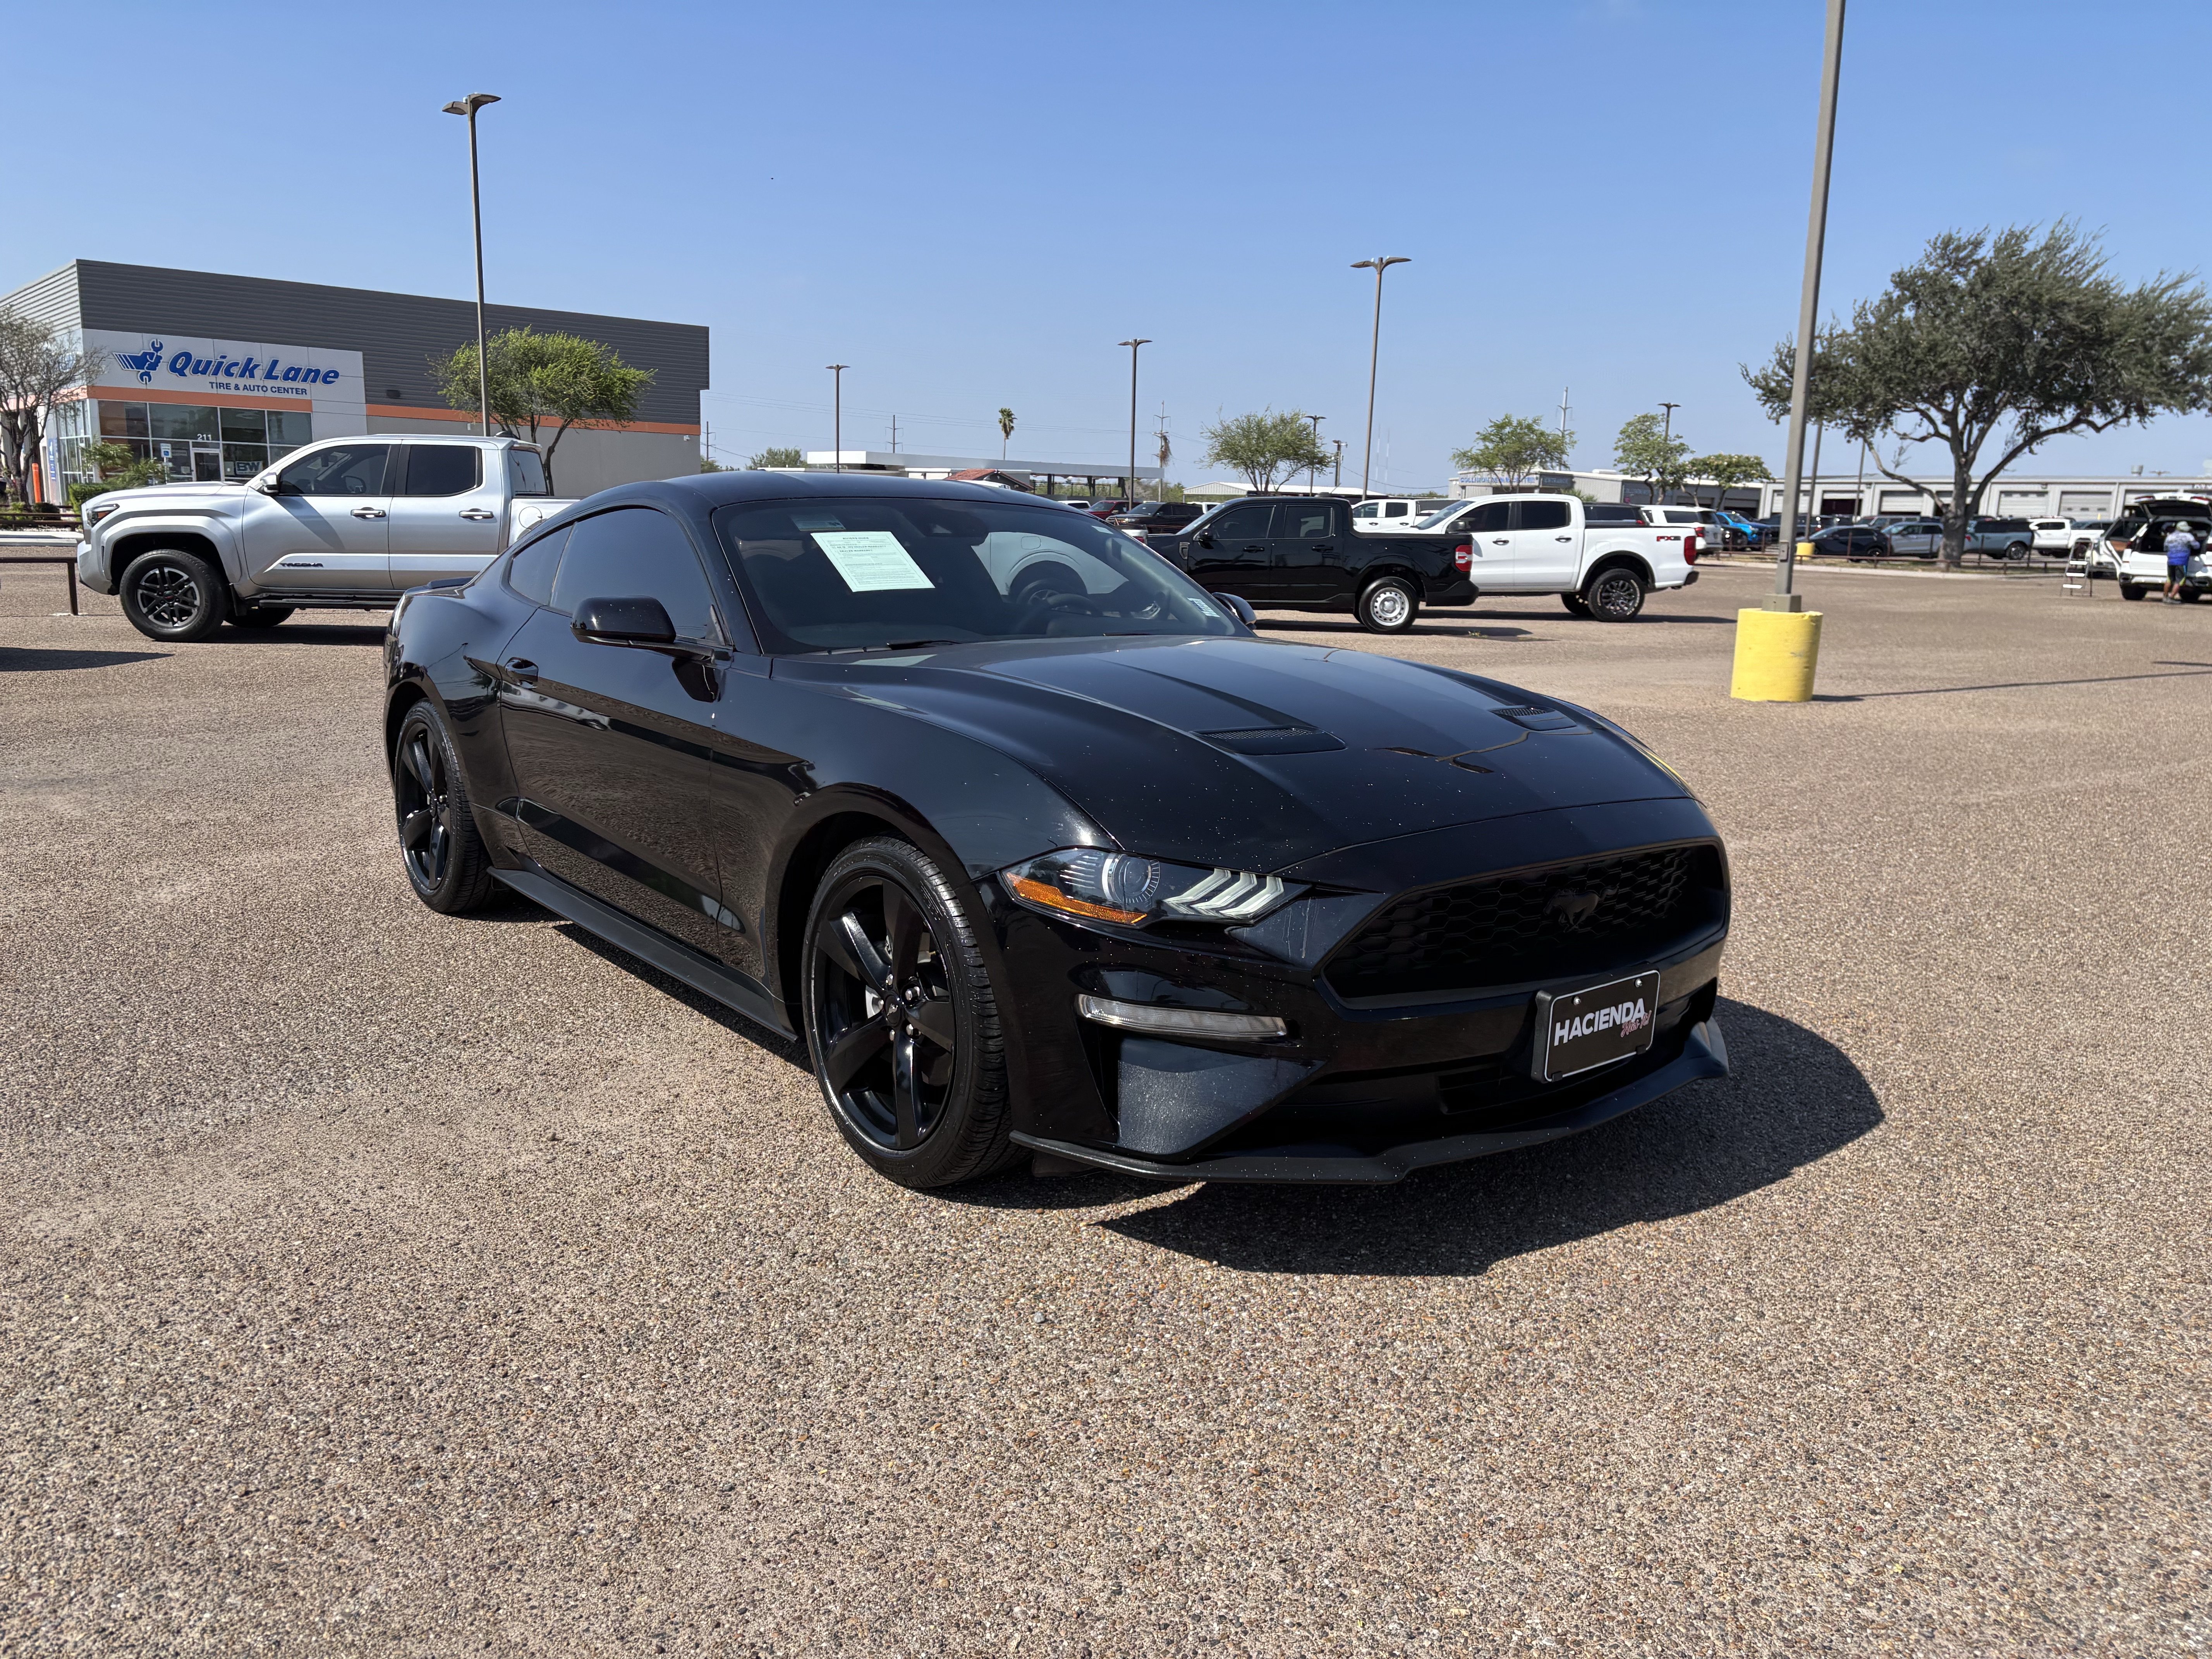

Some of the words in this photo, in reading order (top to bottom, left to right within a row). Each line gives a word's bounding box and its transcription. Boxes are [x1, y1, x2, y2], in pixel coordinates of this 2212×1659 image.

[169, 351, 261, 377] Quick
[264, 359, 340, 384] Lane
[209, 381, 231, 390] TIRE
[242, 384, 268, 392] AUTO
[271, 386, 307, 395] CENTER
[1554, 998, 1645, 1046] HACIENDA
